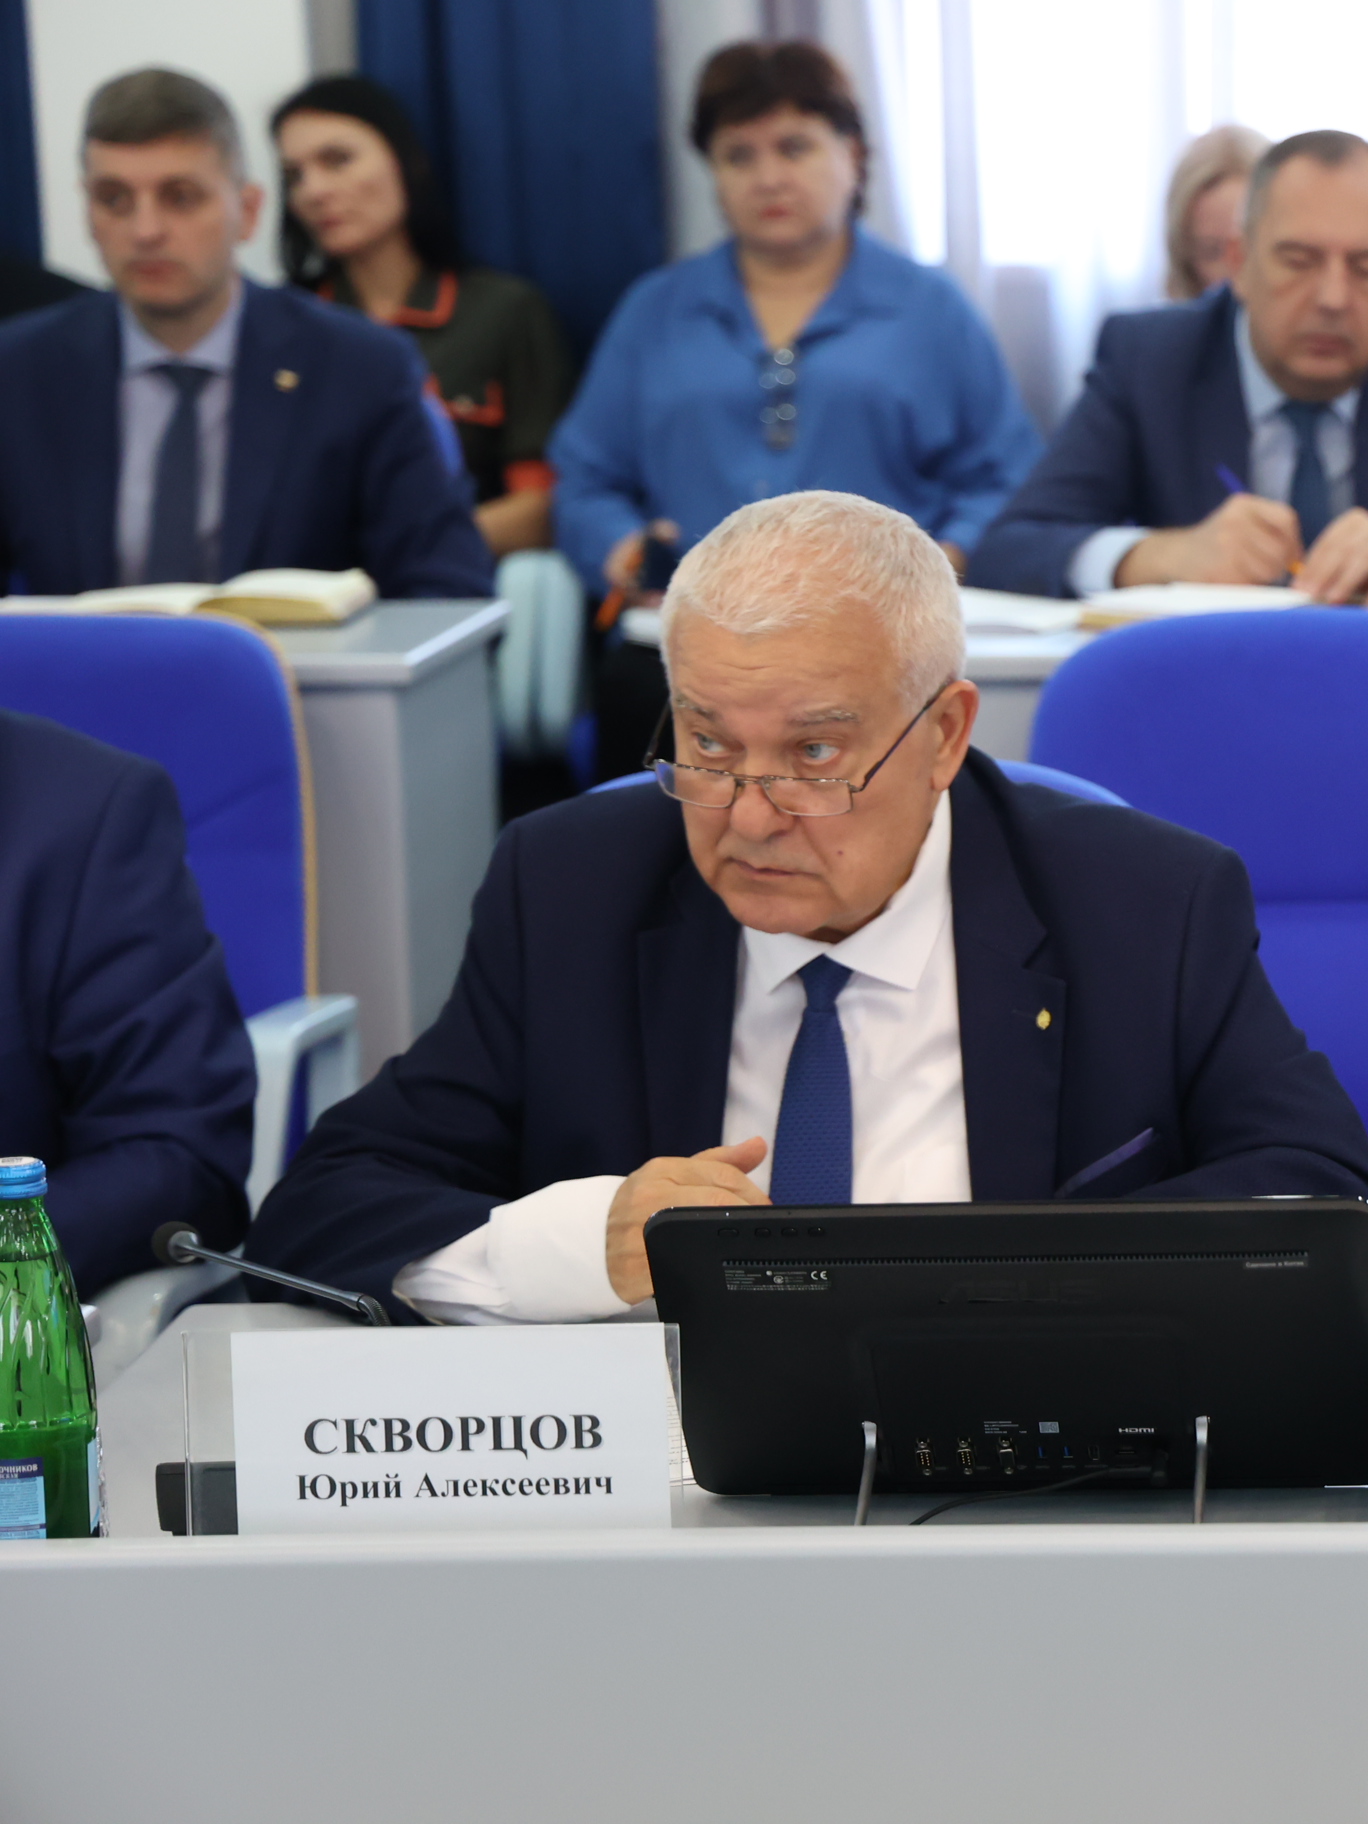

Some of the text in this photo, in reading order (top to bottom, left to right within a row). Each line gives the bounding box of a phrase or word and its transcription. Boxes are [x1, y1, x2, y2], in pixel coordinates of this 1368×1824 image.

[304, 1414, 603, 1460] СКВОРЦОВ
[297, 1472, 613, 1507] Юрий Алексеевич
